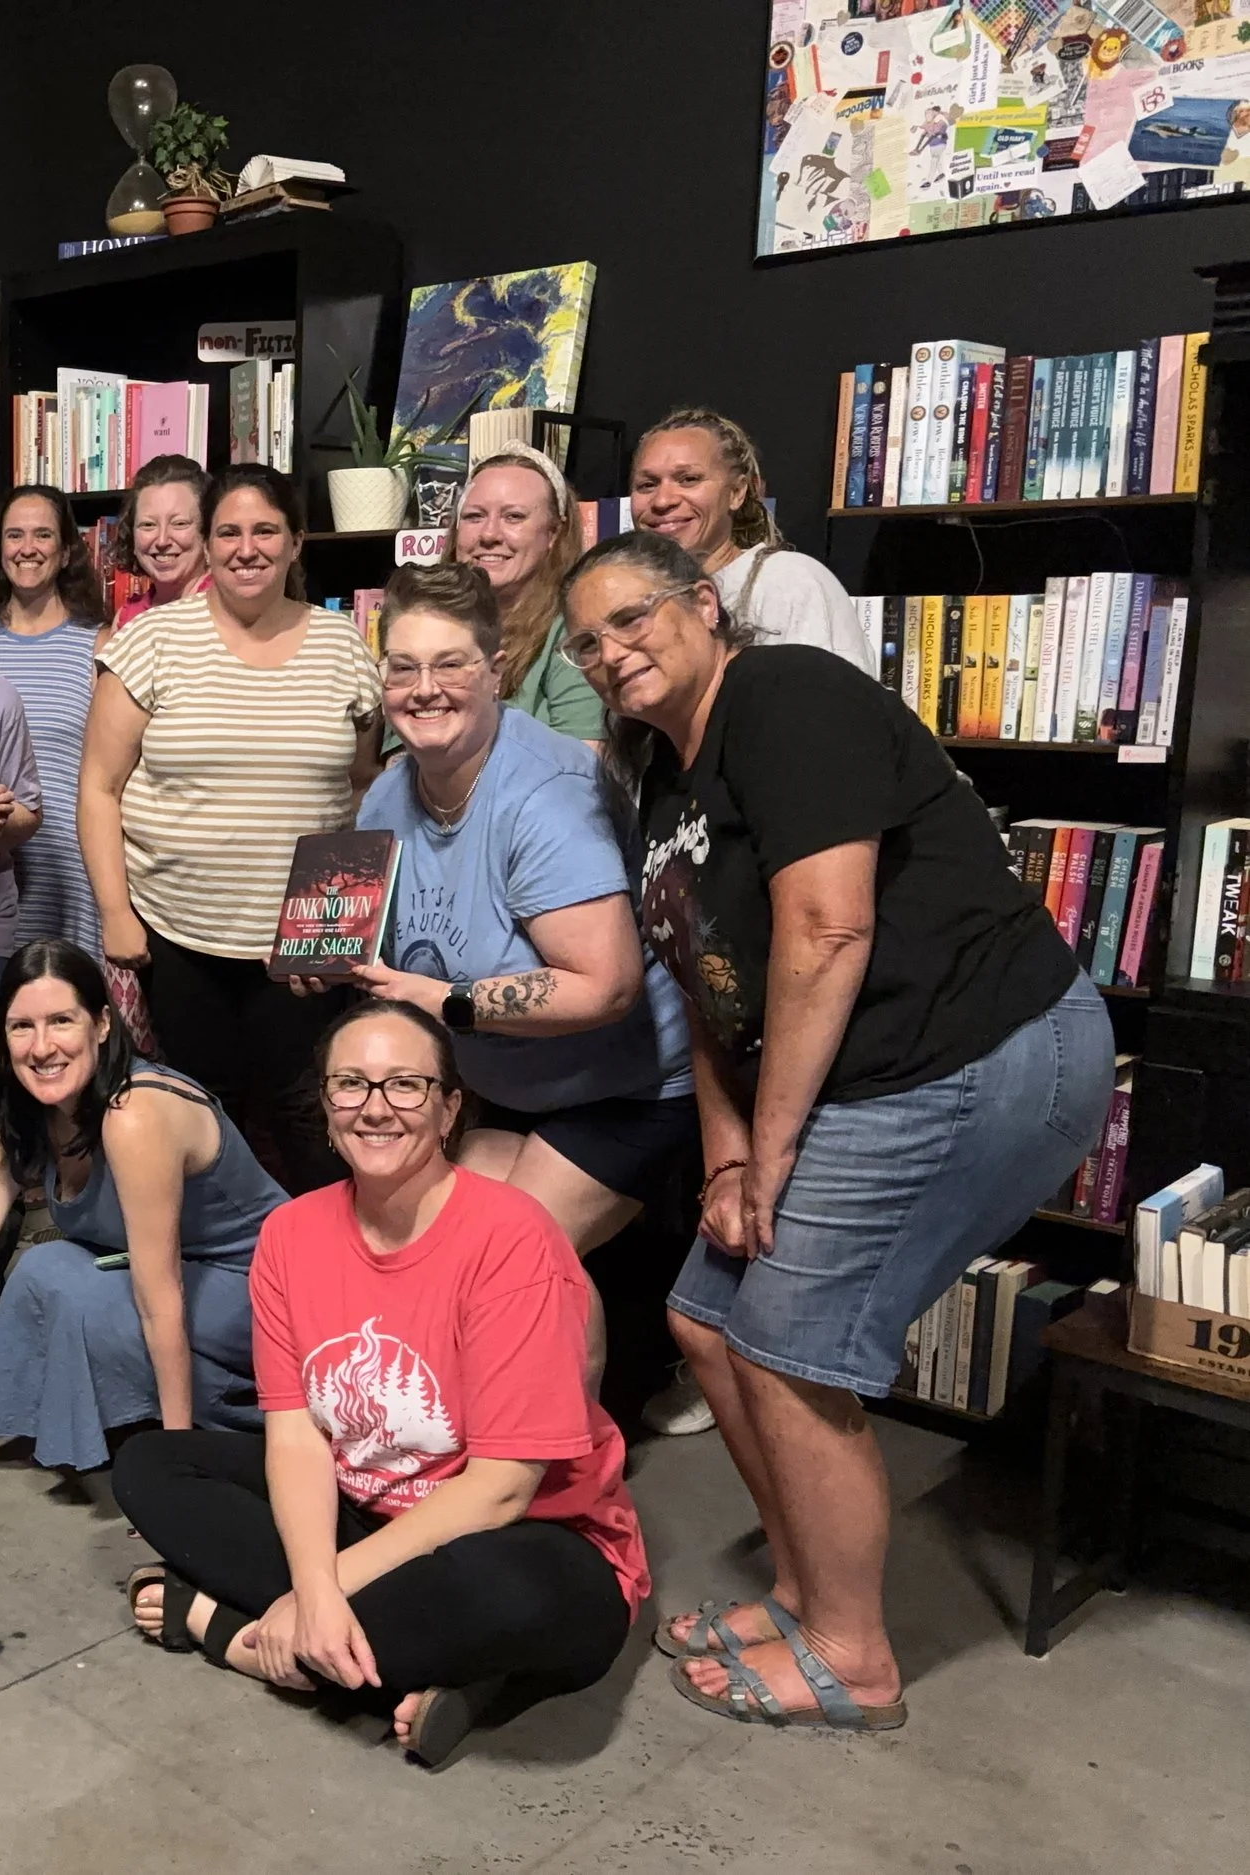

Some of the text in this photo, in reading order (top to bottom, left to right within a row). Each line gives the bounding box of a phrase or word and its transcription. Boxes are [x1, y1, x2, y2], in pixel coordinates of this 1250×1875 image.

[968, 33, 981, 104] Girls just wanna
[1173, 59, 1204, 73] BOOKS
[978, 82, 987, 103] have
[976, 184, 1002, 192] again.
[977, 171, 998, 181] Until
[1015, 168, 1035, 176] read
[1141, 348, 1153, 370] Meet
[960, 381, 969, 411] CHASING
[977, 383, 987, 409] SMITTEN
[1070, 370, 1082, 428] ARCHER'S VOICE
[1089, 368, 1100, 426] ARCHER'S VOICE
[1117, 367, 1128, 400] TRAVIS
[1051, 371, 1064, 429] ARCHER'S VOICE
[1184, 353, 1200, 451] NICHOLAS SPARKS
[852, 404, 867, 457] NORA ROBERTS
[869, 404, 885, 457] NORA ROBERTS
[911, 406, 926, 443] Vows
[933, 405, 950, 443] Vows
[957, 428, 965, 444] RING
[1134, 432, 1147, 447] Life
[1088, 576, 1105, 646] DANIELLE STEEL
[1109, 577, 1127, 653] DANIELLE STEEL
[1127, 581, 1144, 657] DANIELLE STEEL
[1041, 603, 1057, 666] DANIELLE STEEL
[1061, 610, 1079, 686] DANIELLE STEEL
[1170, 618, 1178, 647] FALLING
[905, 605, 917, 692] NICHOLAS SPARKS
[922, 613, 935, 700] NICHOLAS SPARKS
[1026, 852, 1037, 882] WALSH
[1034, 853, 1045, 883] CHLOE
[1049, 851, 1059, 882] WALSH
[1056, 852, 1067, 882] CHLOE
[1068, 853, 1079, 884] WALSH
[1076, 854, 1087, 884] CHLOE
[1109, 857, 1121, 888] WALSH
[1118, 858, 1129, 889] CHLOE
[326, 886, 339, 896] THE
[412, 886, 456, 912] IT'S A
[1220, 873, 1241, 936] TWEAK
[286, 896, 373, 920] UNKNOWN
[279, 937, 363, 956] RILEY SAGER
[1106, 1122, 1120, 1152] SUNDAY
[1116, 1109, 1131, 1146] HAPPENED
